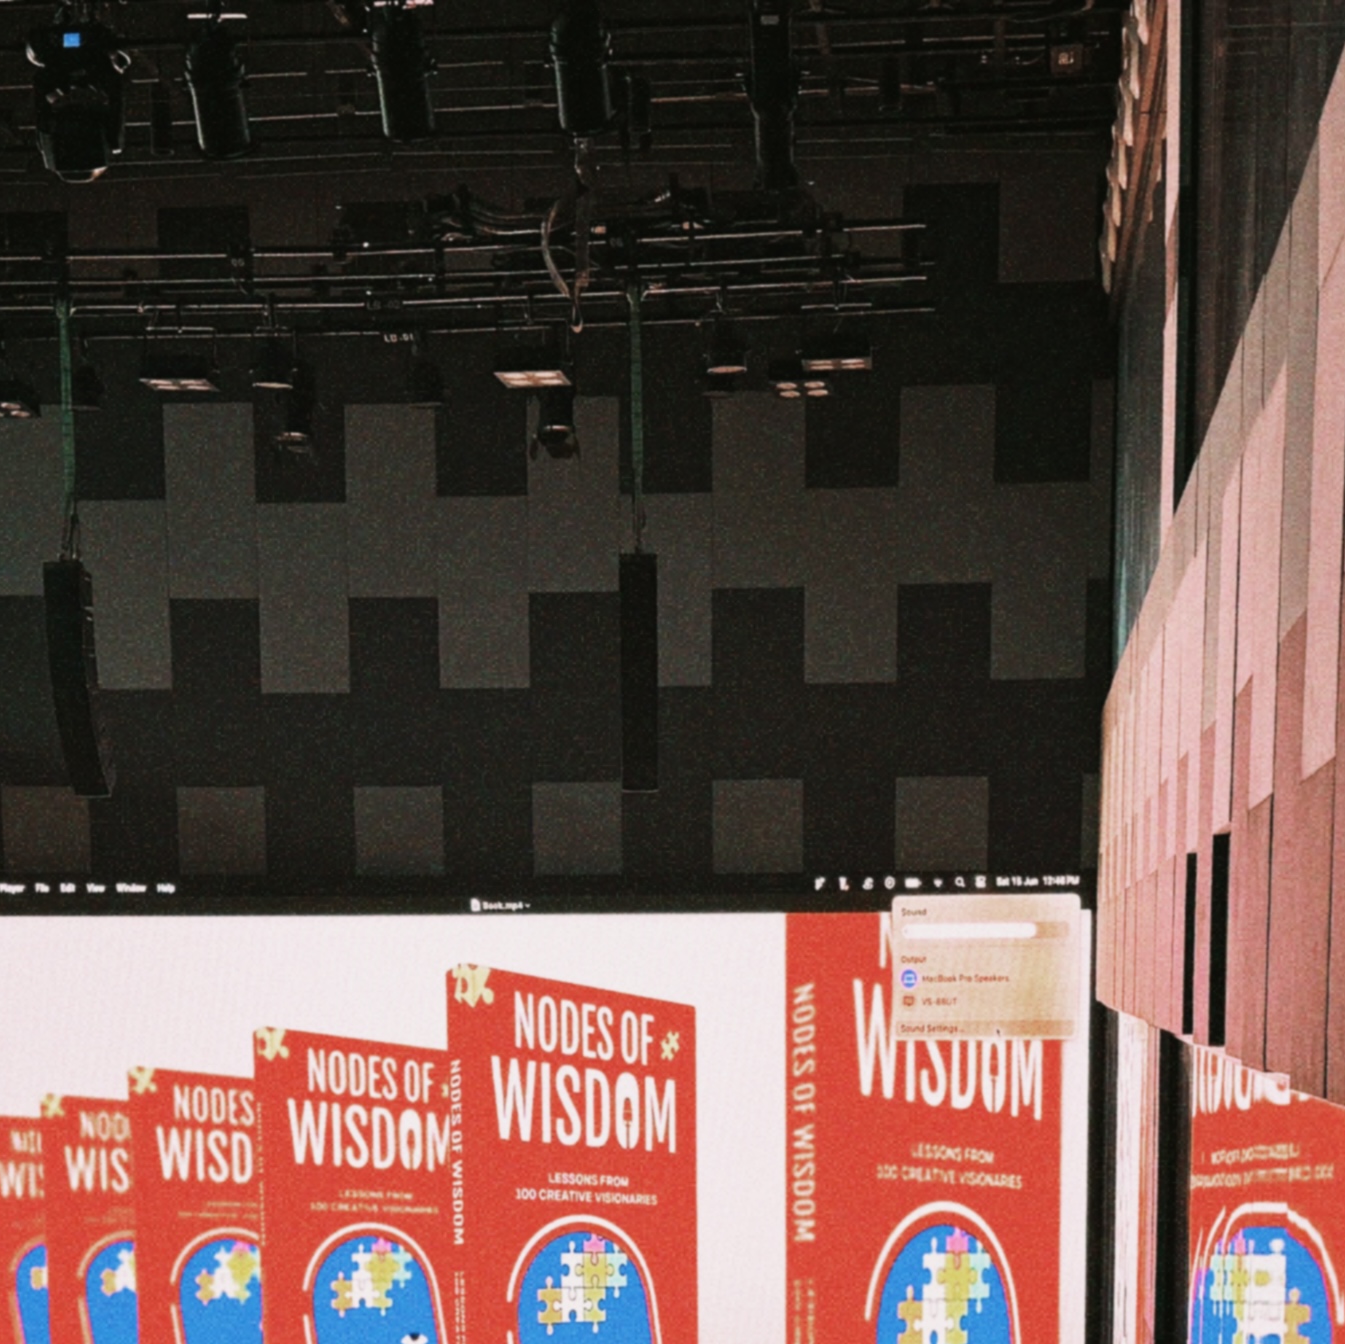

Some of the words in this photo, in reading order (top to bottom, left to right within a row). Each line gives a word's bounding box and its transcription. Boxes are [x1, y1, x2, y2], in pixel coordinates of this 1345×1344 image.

[0, 883, 25, 895] Player
[35, 882, 50, 893] File
[60, 882, 76, 893] Edit
[86, 883, 106, 893] View
[116, 883, 147, 893] Window
[157, 882, 176, 894] Help
[901, 907, 927, 917] Sound
[901, 955, 927, 964] Output
[922, 973, 957, 983] MacBook
[959, 973, 972, 982] Pro
[974, 973, 1009, 983] Speakers
[514, 990, 614, 1062] NODES
[620, 1010, 655, 1066] OF
[793, 982, 816, 1077] NODES
[900, 1024, 925, 1034] Sound
[853, 977, 1043, 1121] WISDOM
[307, 1047, 397, 1100] NODES
[404, 1059, 435, 1104] OF
[173, 1084, 255, 1127] NODES
[450, 1059, 463, 1127] NODES
[490, 1054, 677, 1154] WISDOM
[793, 1083, 816, 1113] OF
[287, 1097, 450, 1172] WISDOM
[451, 1130, 463, 1153] OF
[911, 1142, 962, 1163] LESSONS
[964, 1147, 995, 1164] FROM
[548, 1172, 598, 1187] LESSONS
[600, 1174, 629, 1188] FROM
[792, 1122, 817, 1243] WISDOM
[902, 1166, 956, 1186] CREATIVE
[959, 1170, 1023, 1190] VISIONARIES
[452, 1159, 465, 1246] WISDOM
[515, 1187, 537, 1200] 100
[539, 1188, 592, 1203] CREATIVE
[595, 1190, 658, 1205] VISIONARIES
